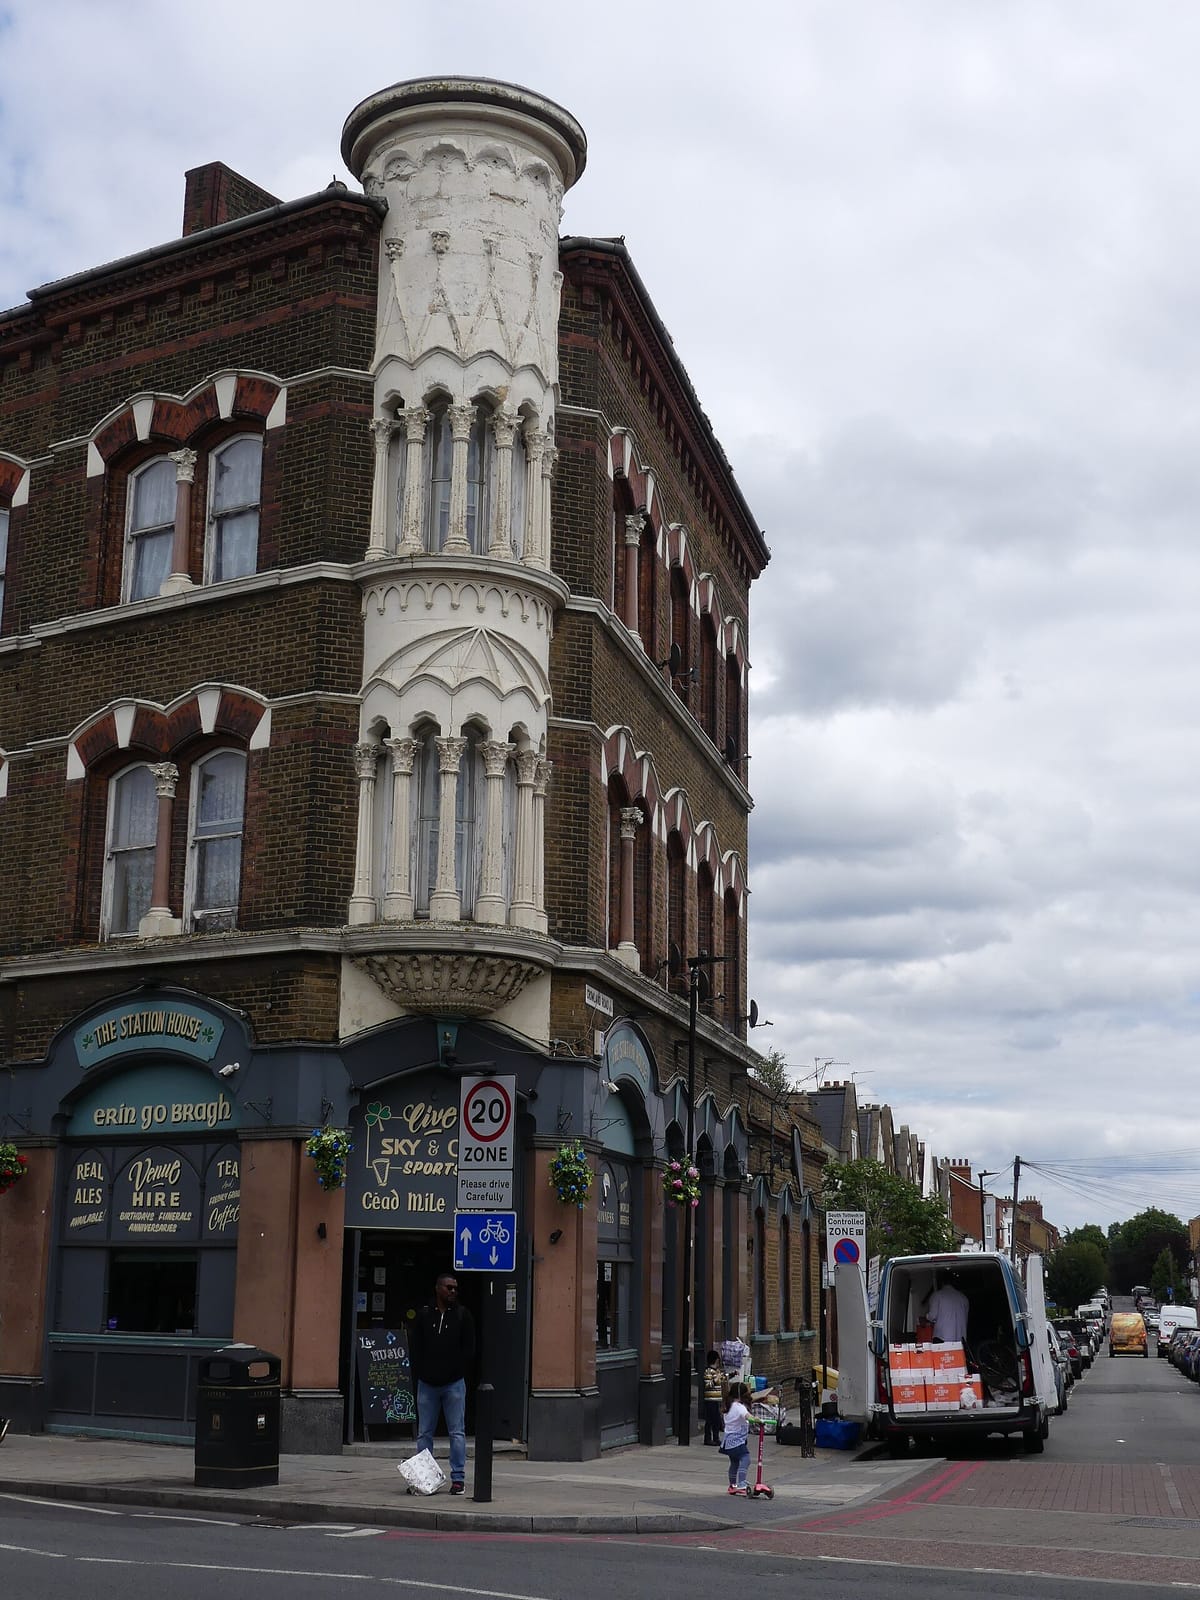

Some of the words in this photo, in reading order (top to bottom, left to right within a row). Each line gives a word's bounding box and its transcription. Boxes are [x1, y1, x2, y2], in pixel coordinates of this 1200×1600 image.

[94, 1019, 117, 1048] THE
[120, 1010, 165, 1039] STATION
[166, 1011, 203, 1042] HOUSE
[402, 1102, 458, 1134] Live
[471, 1098, 505, 1124] 20
[380, 1138, 422, 1156] SKY
[427, 1139, 440, 1157] &
[463, 1146, 508, 1162] ZONE
[76, 1162, 104, 1181] REAL
[128, 1158, 182, 1191] Venue
[216, 1159, 240, 1178] TEA
[460, 1180, 487, 1189] Please
[489, 1179, 510, 1189] drive
[74, 1188, 103, 1205] ALES
[132, 1191, 181, 1207] HIRE
[465, 1191, 504, 1203] Carefully
[829, 1227, 854, 1236] ZONE
